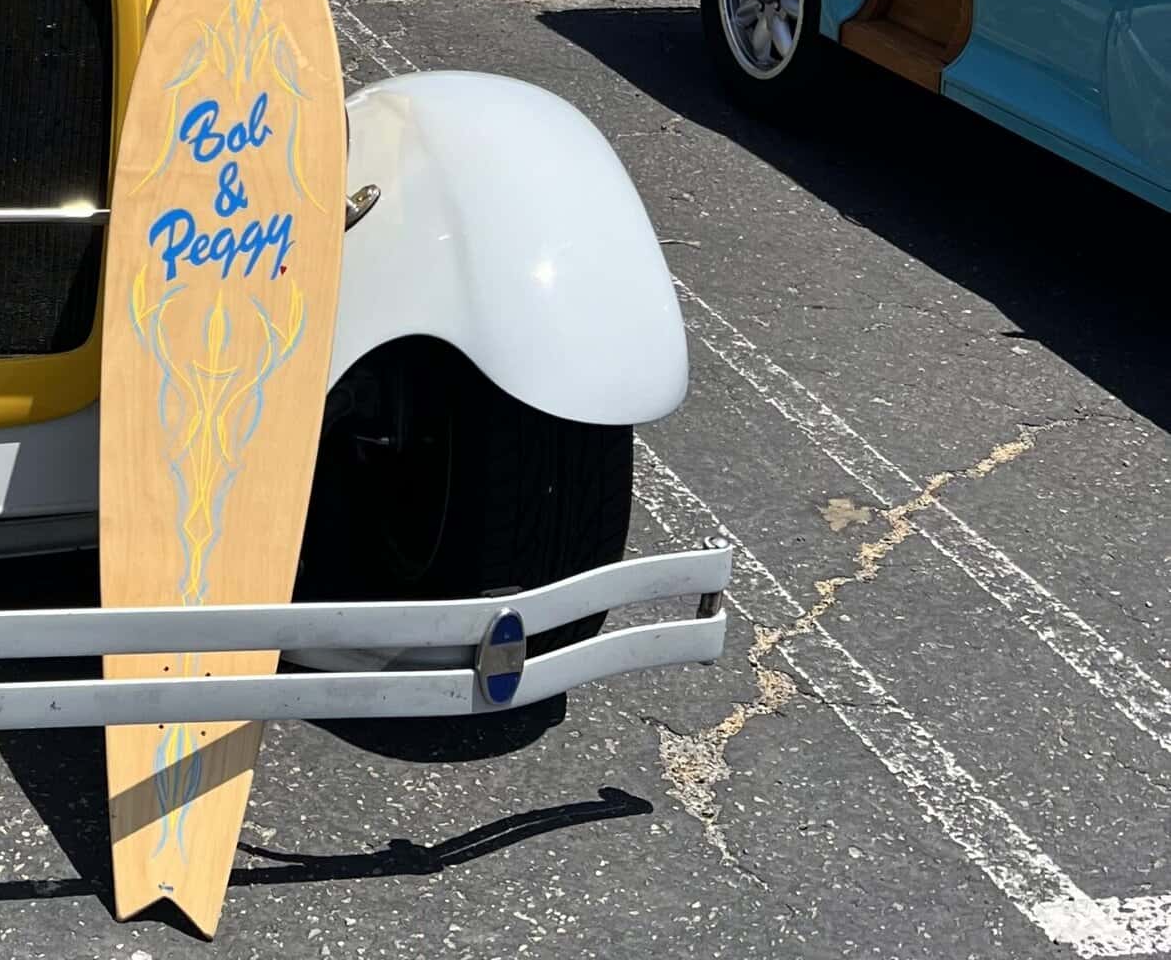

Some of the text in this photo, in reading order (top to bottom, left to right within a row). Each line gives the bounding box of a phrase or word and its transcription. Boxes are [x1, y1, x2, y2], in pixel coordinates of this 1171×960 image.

[179, 91, 273, 163] Bob
[214, 161, 249, 218] &
[148, 207, 296, 281] Peggy
